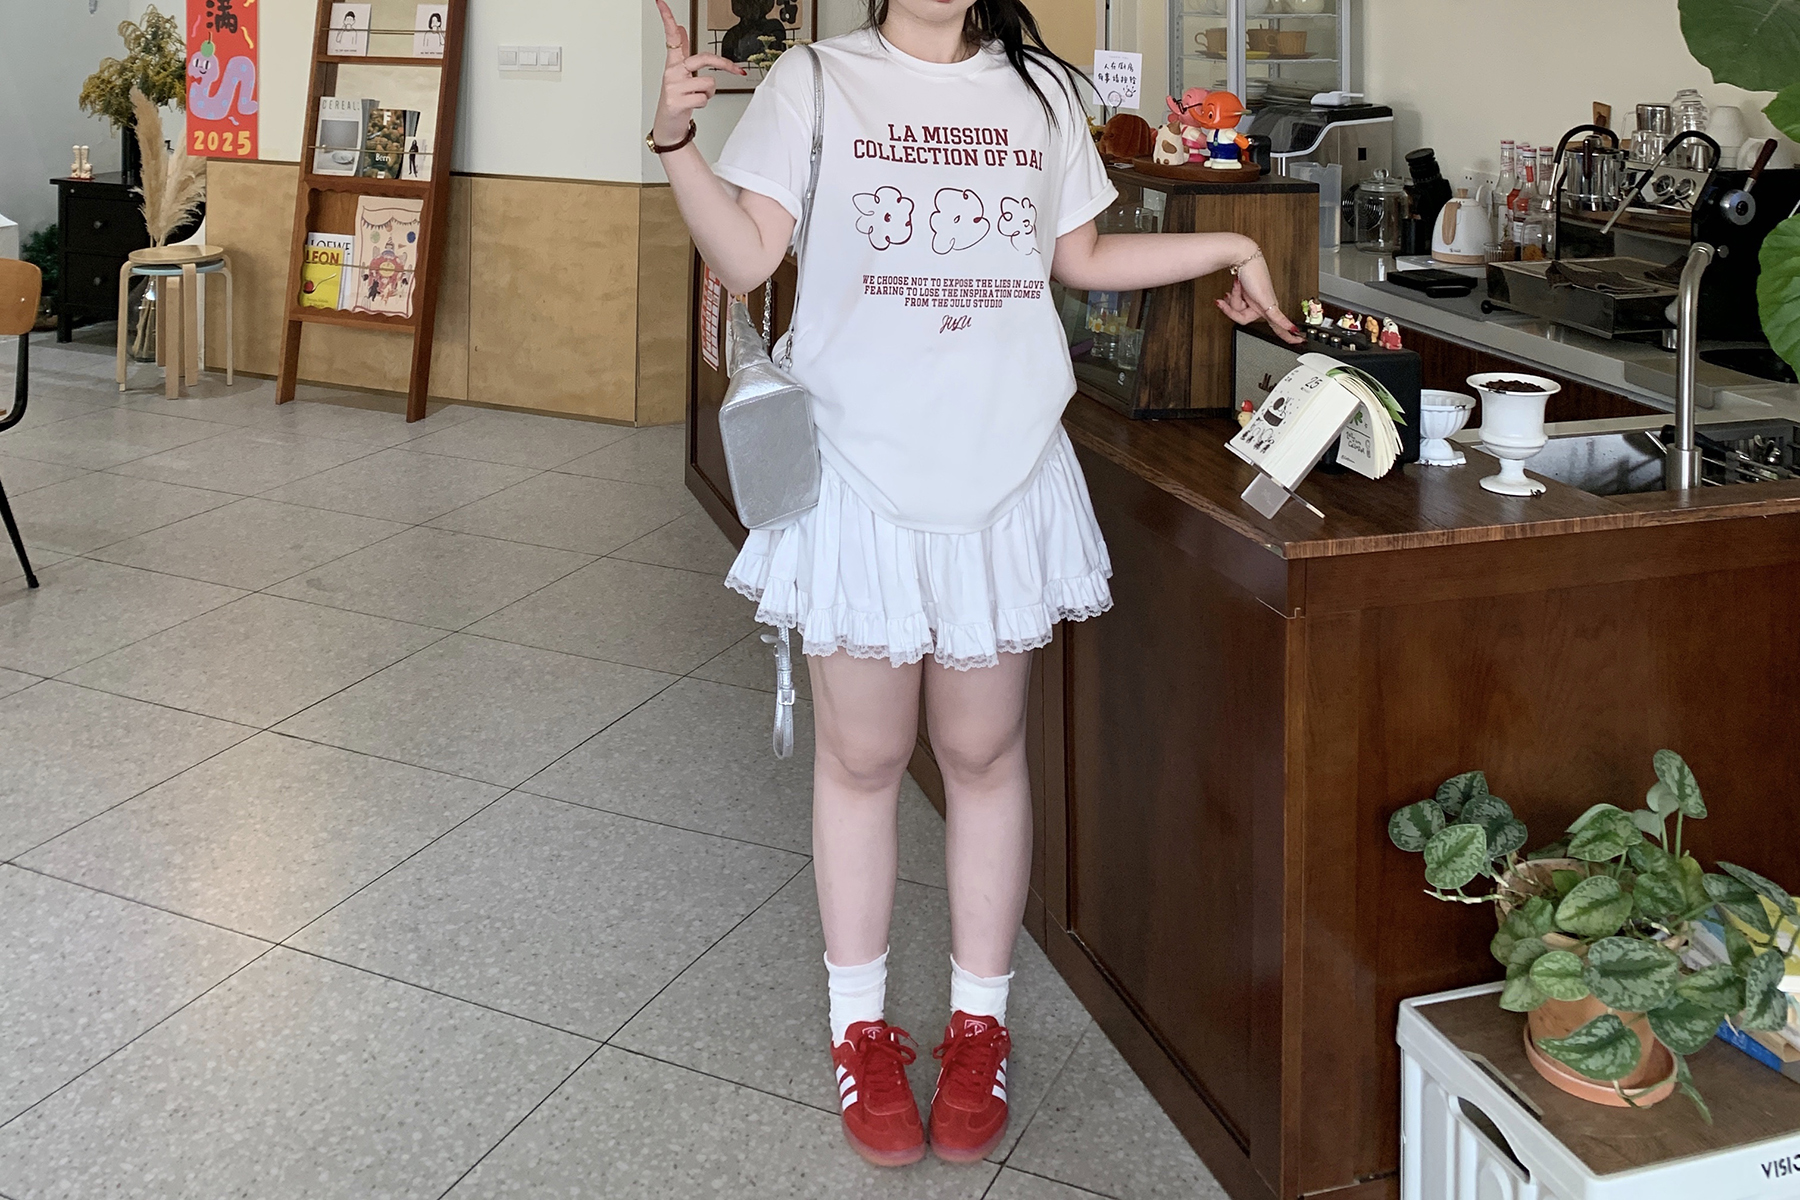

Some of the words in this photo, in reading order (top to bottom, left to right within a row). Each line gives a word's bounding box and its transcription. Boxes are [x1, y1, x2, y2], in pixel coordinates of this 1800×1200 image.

[322, 99, 357, 111] CEREAL
[382, 111, 392, 126] F
[887, 123, 918, 143] LA
[921, 125, 1009, 146] MISSION
[194, 130, 251, 156] 2025
[853, 139, 979, 166] COLLECTION
[984, 148, 1008, 167] OF
[862, 274, 875, 285] WE
[876, 275, 909, 286] CHOOSE
[911, 276, 928, 287] NOT
[931, 278, 941, 287] TO
[943, 278, 974, 288] EXPOSE
[975, 279, 993, 288] THE
[994, 279, 1011, 288] LIES
[1012, 279, 1021, 288] IN
[1023, 280, 1044, 290] LOVE
[864, 285, 904, 296] FEARING
[906, 286, 917, 296] TO
[919, 287, 940, 297] LOSE
[941, 288, 959, 298] THE
[959, 288, 1012, 298] INSPIRATION
[1013, 289, 1041, 299] COMES
[904, 297, 929, 307] FROM
[931, 298, 949, 308] THE
[949, 298, 971, 308] JULU
[972, 298, 1003, 308] STUDIO
